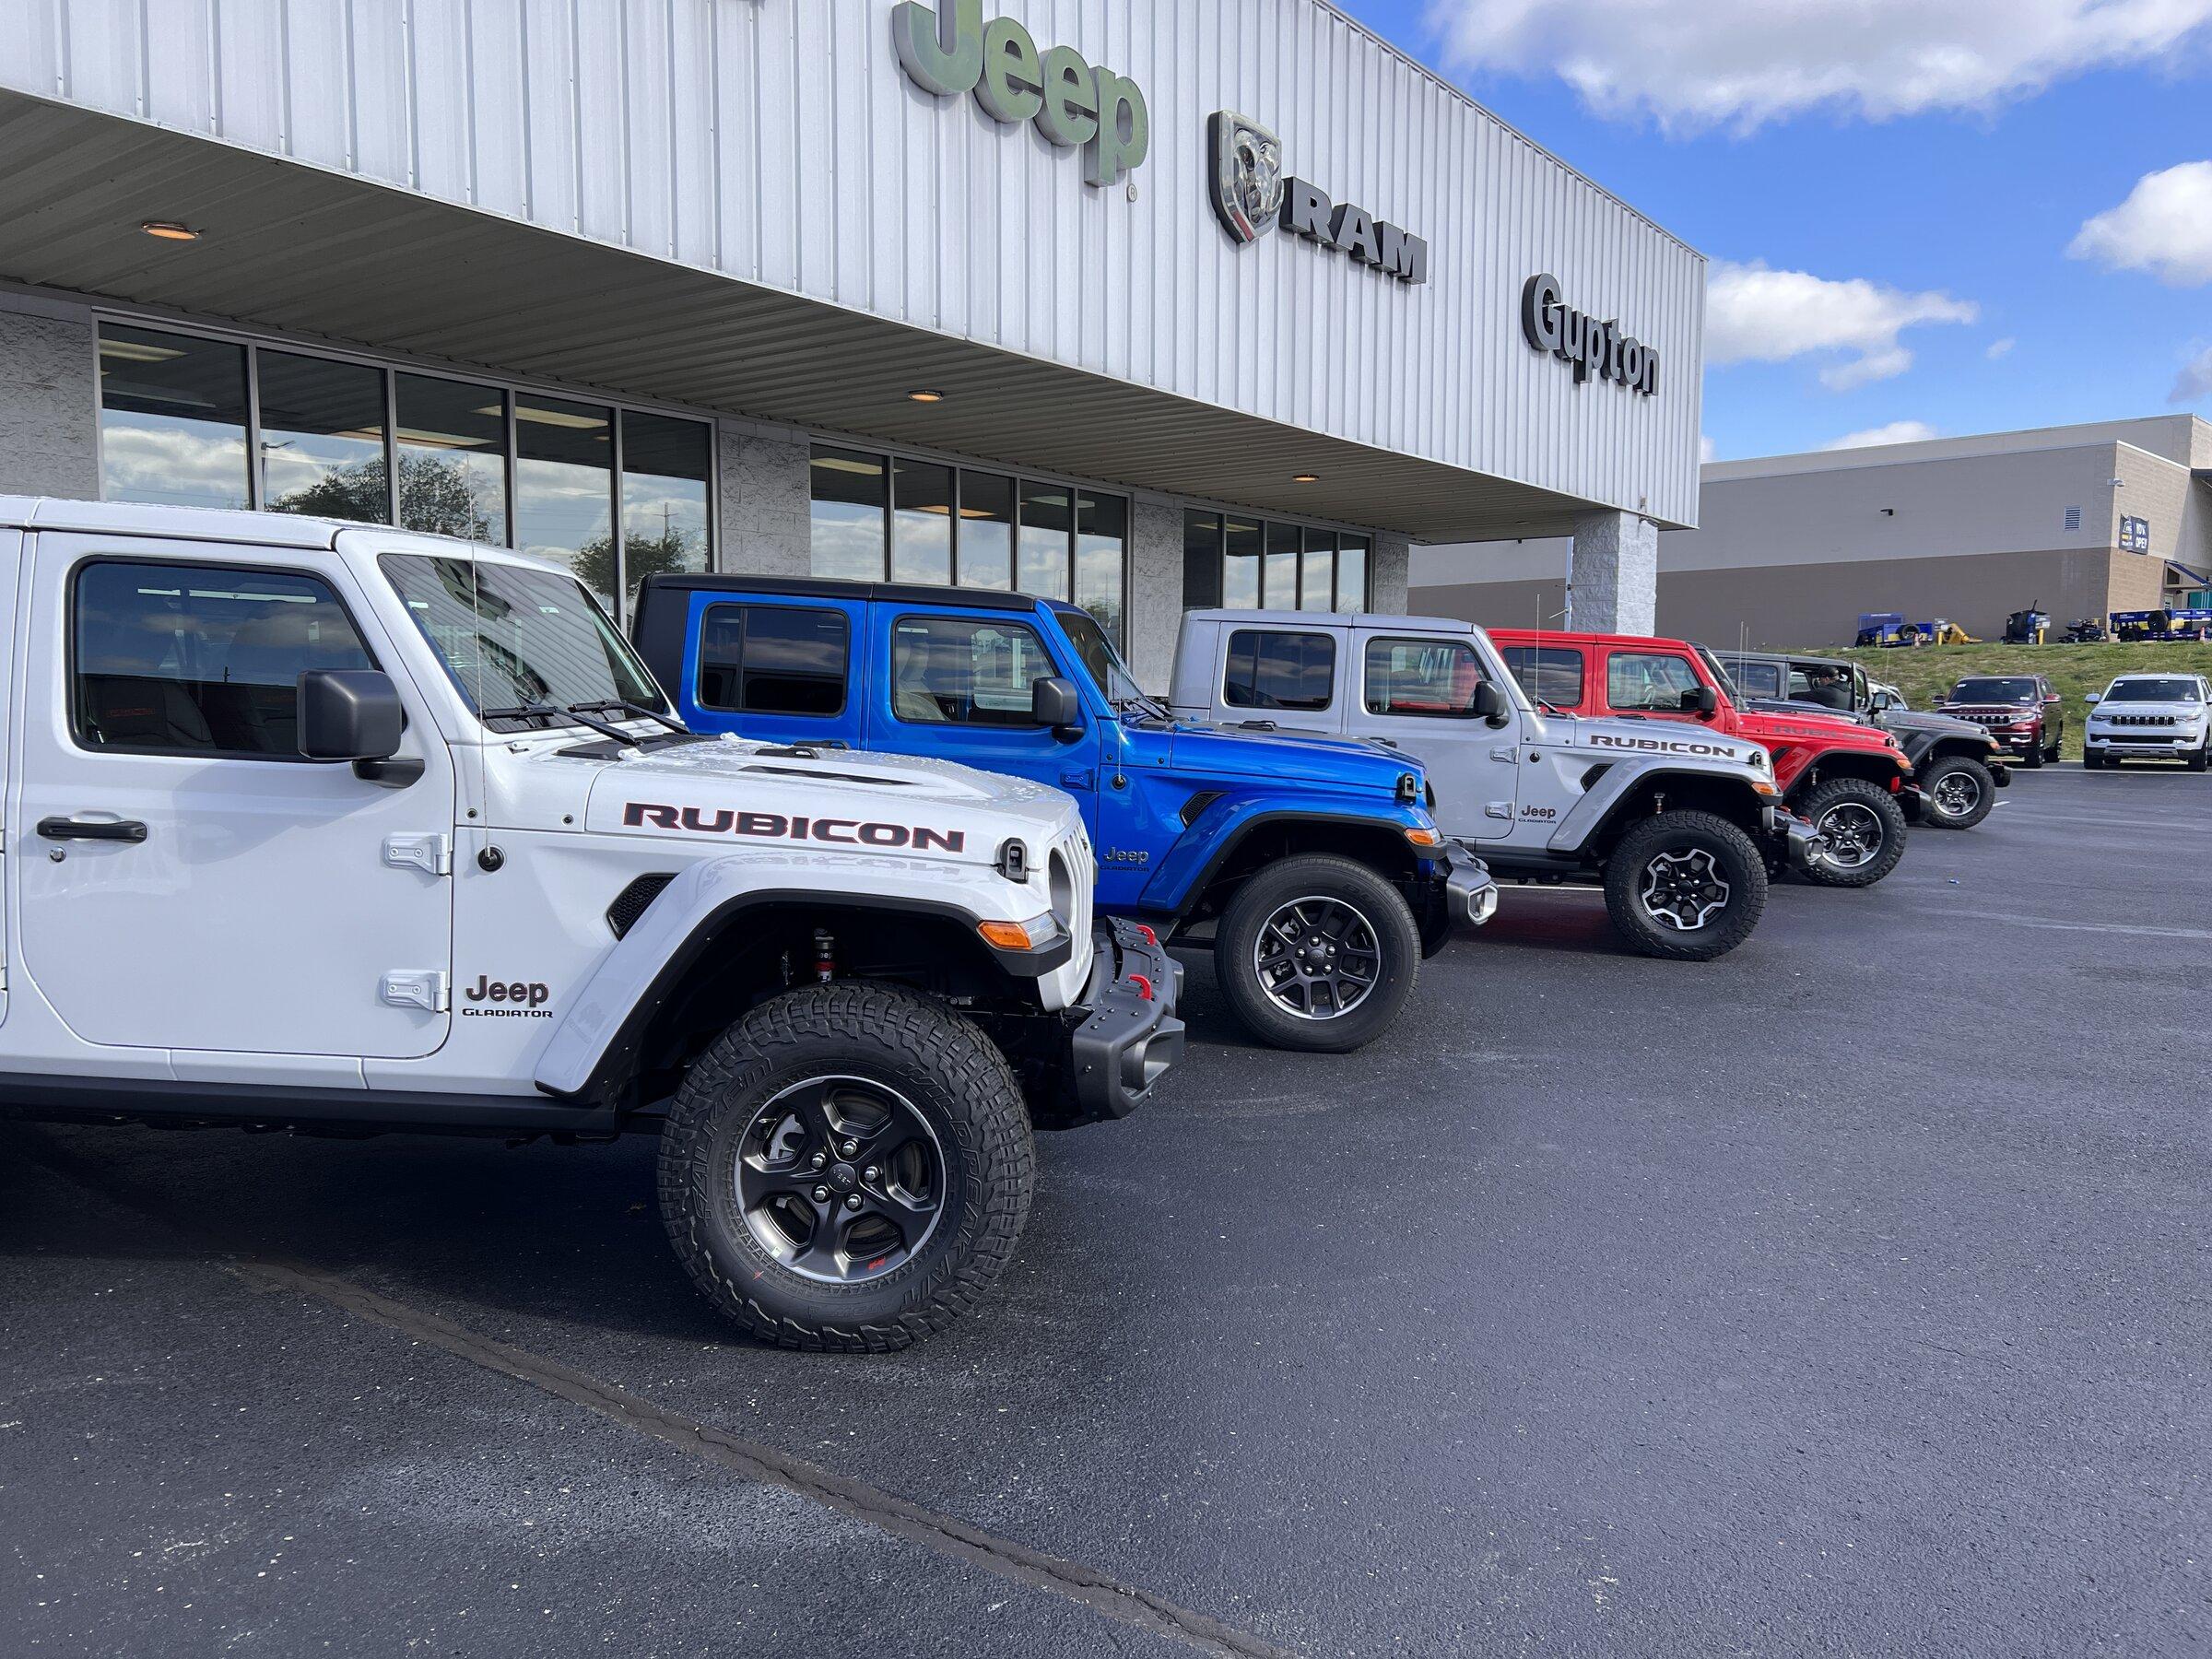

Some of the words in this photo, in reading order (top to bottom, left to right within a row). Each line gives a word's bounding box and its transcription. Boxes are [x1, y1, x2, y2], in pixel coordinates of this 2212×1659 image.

[893, 0, 1149, 187] Jeep
[1279, 175, 1428, 285] RAM
[1522, 273, 1660, 396] Gupton
[1590, 735, 1735, 758] RUBICON
[623, 802, 965, 853] RUBICON
[1521, 805, 1557, 819] Jeep
[1103, 846, 1149, 865] Jeep
[465, 974, 549, 1008] Jeep
[462, 1007, 554, 1018] GLADIATOR
[896, 1061, 982, 1260] WILDPEAK
